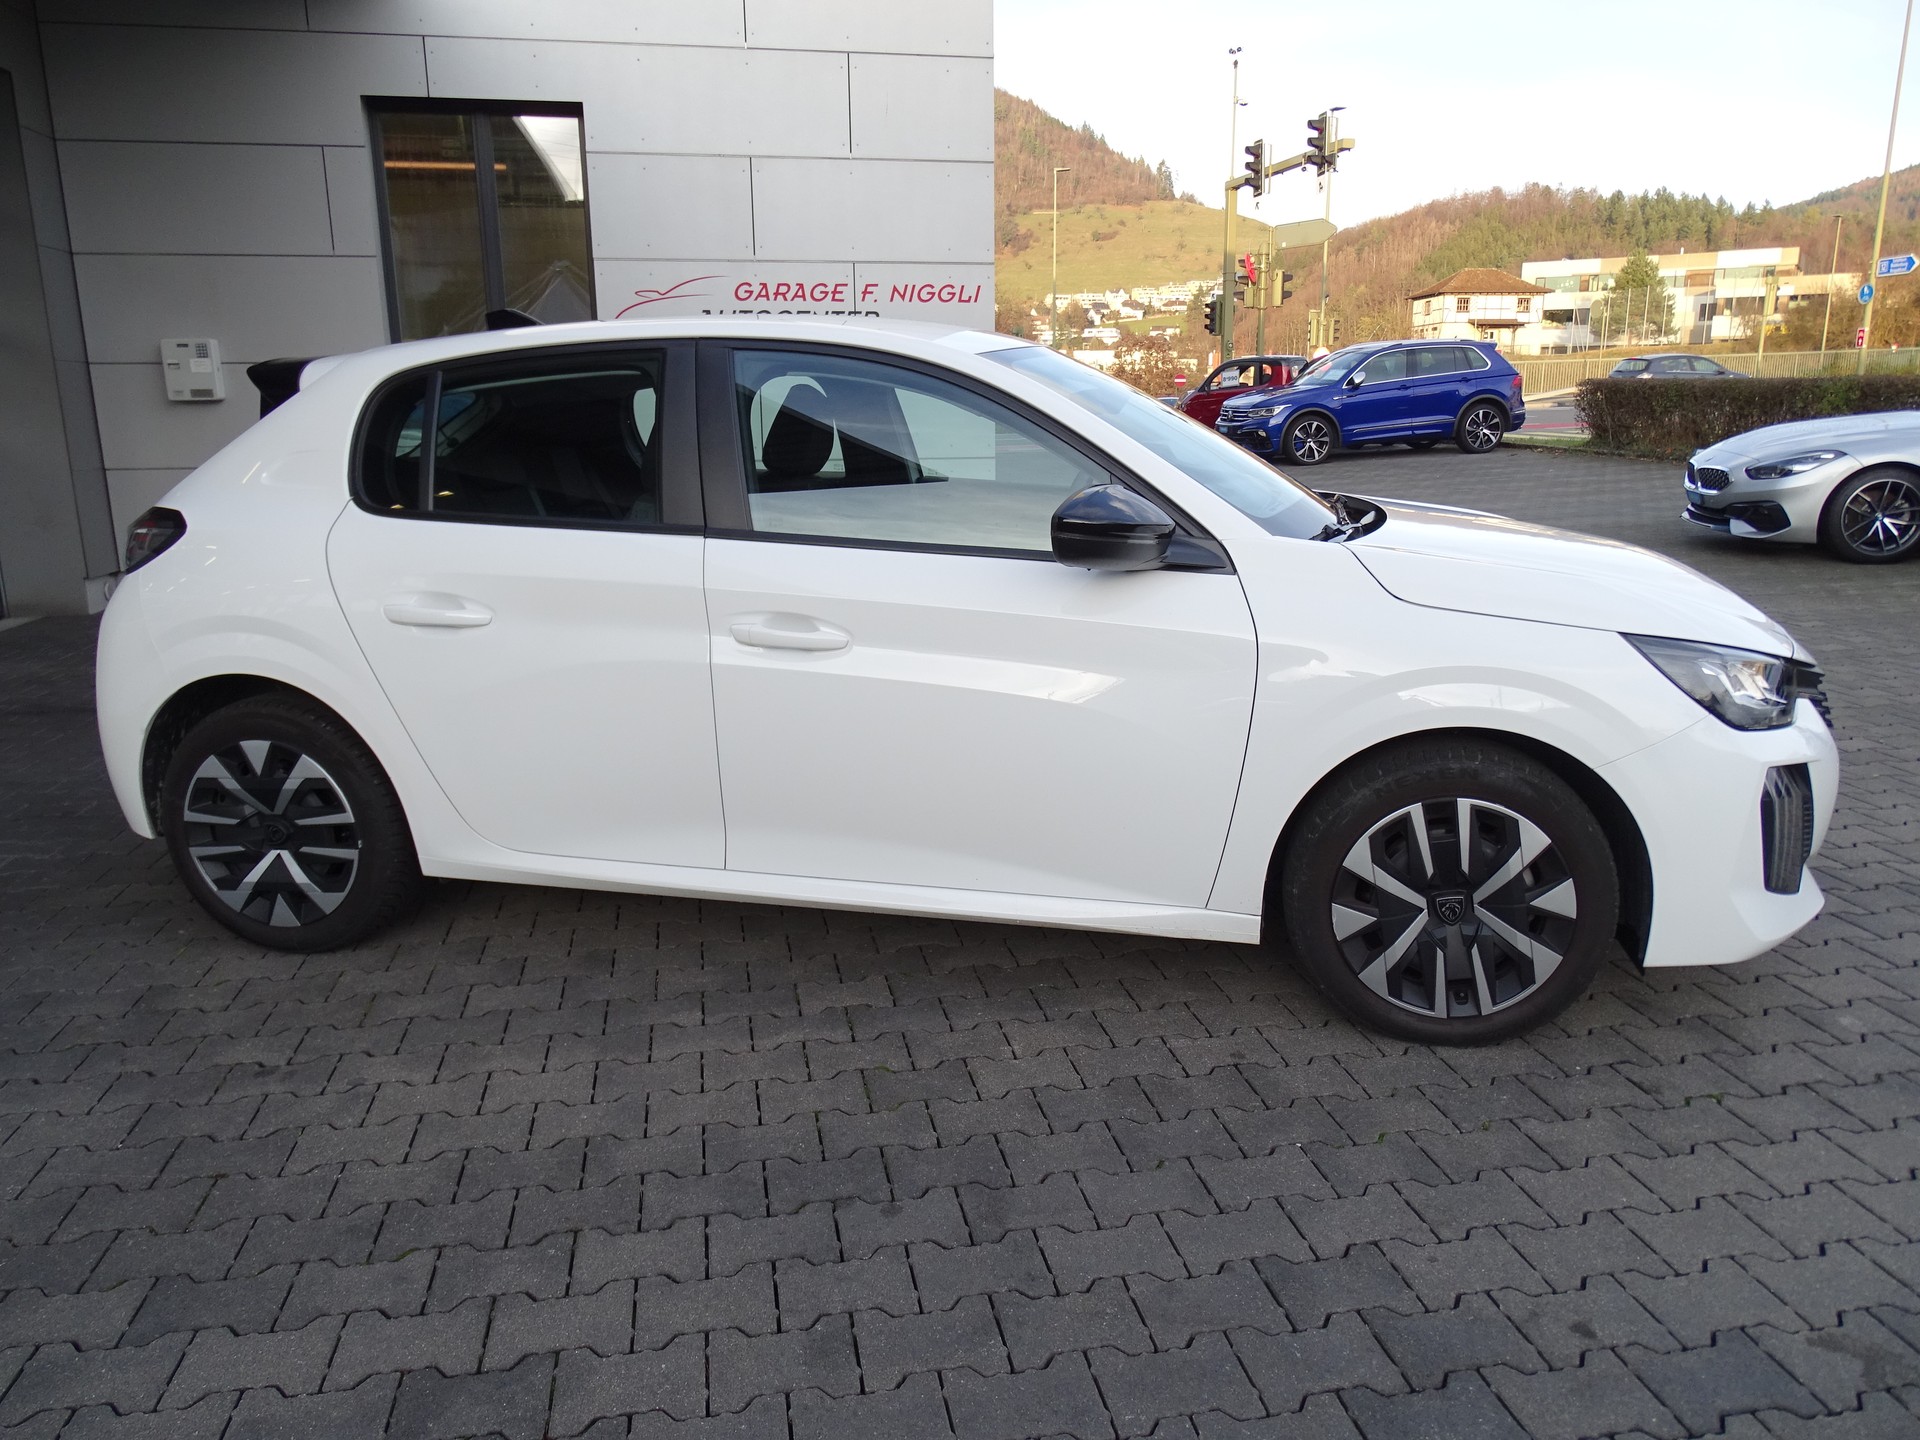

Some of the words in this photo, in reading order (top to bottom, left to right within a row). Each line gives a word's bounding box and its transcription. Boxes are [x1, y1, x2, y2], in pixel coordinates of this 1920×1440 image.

[734, 282, 848, 302] GARAGE
[861, 283, 879, 303] F.
[889, 284, 981, 303] NIGGLI
